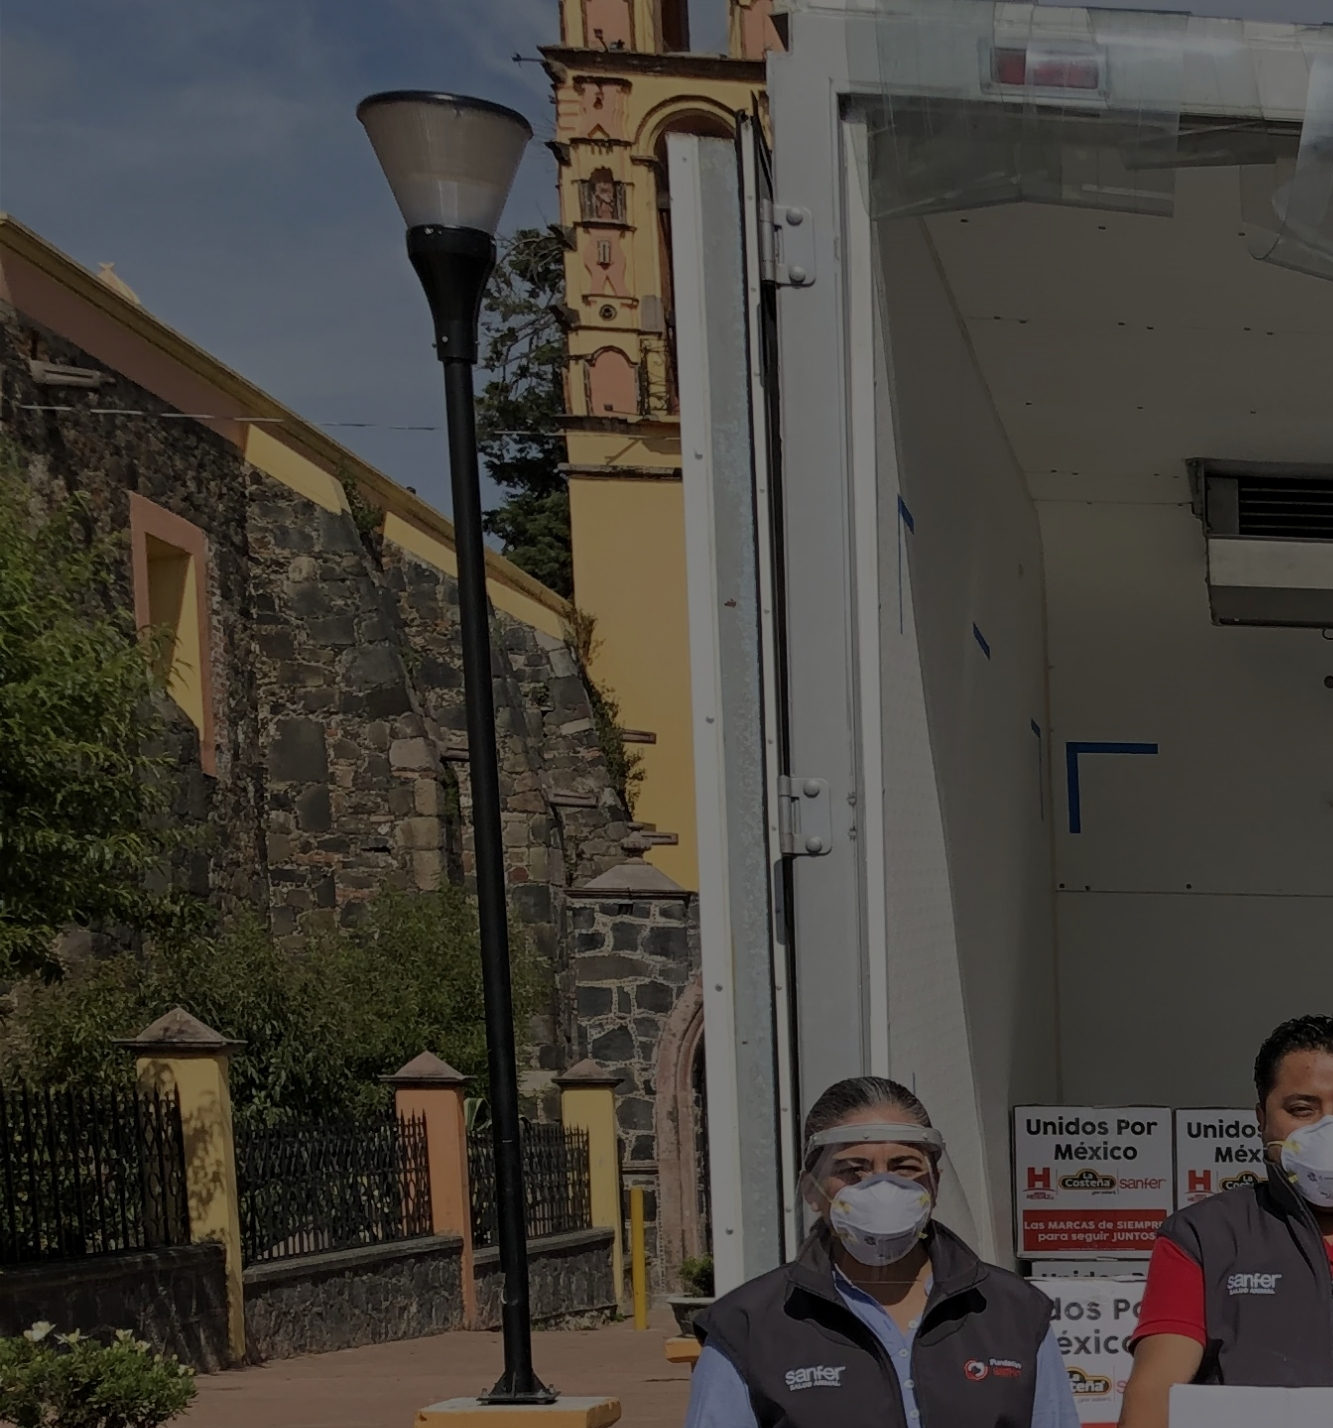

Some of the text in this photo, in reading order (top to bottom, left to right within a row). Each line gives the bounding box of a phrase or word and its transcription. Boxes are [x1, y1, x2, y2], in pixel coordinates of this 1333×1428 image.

[1026, 1116, 1157, 1135] Unidos Por
[1054, 1141, 1137, 1160] México
[1214, 1144, 1261, 1163] Méx
[1082, 1172, 1094, 1180] La
[1119, 1178, 1163, 1189] sanfer
[1024, 1221, 1045, 1230] Las
[1048, 1221, 1095, 1230] MARCAS
[1098, 1220, 1113, 1229] de
[1038, 1231, 1156, 1242] para seguir JUNTOS
[1227, 1272, 1282, 1290] sanfer
[1051, 1298, 1101, 1320] dos
[1057, 1328, 1133, 1355] éxic
[785, 1364, 846, 1386] sanfer
[1072, 1380, 1105, 1392] teña
